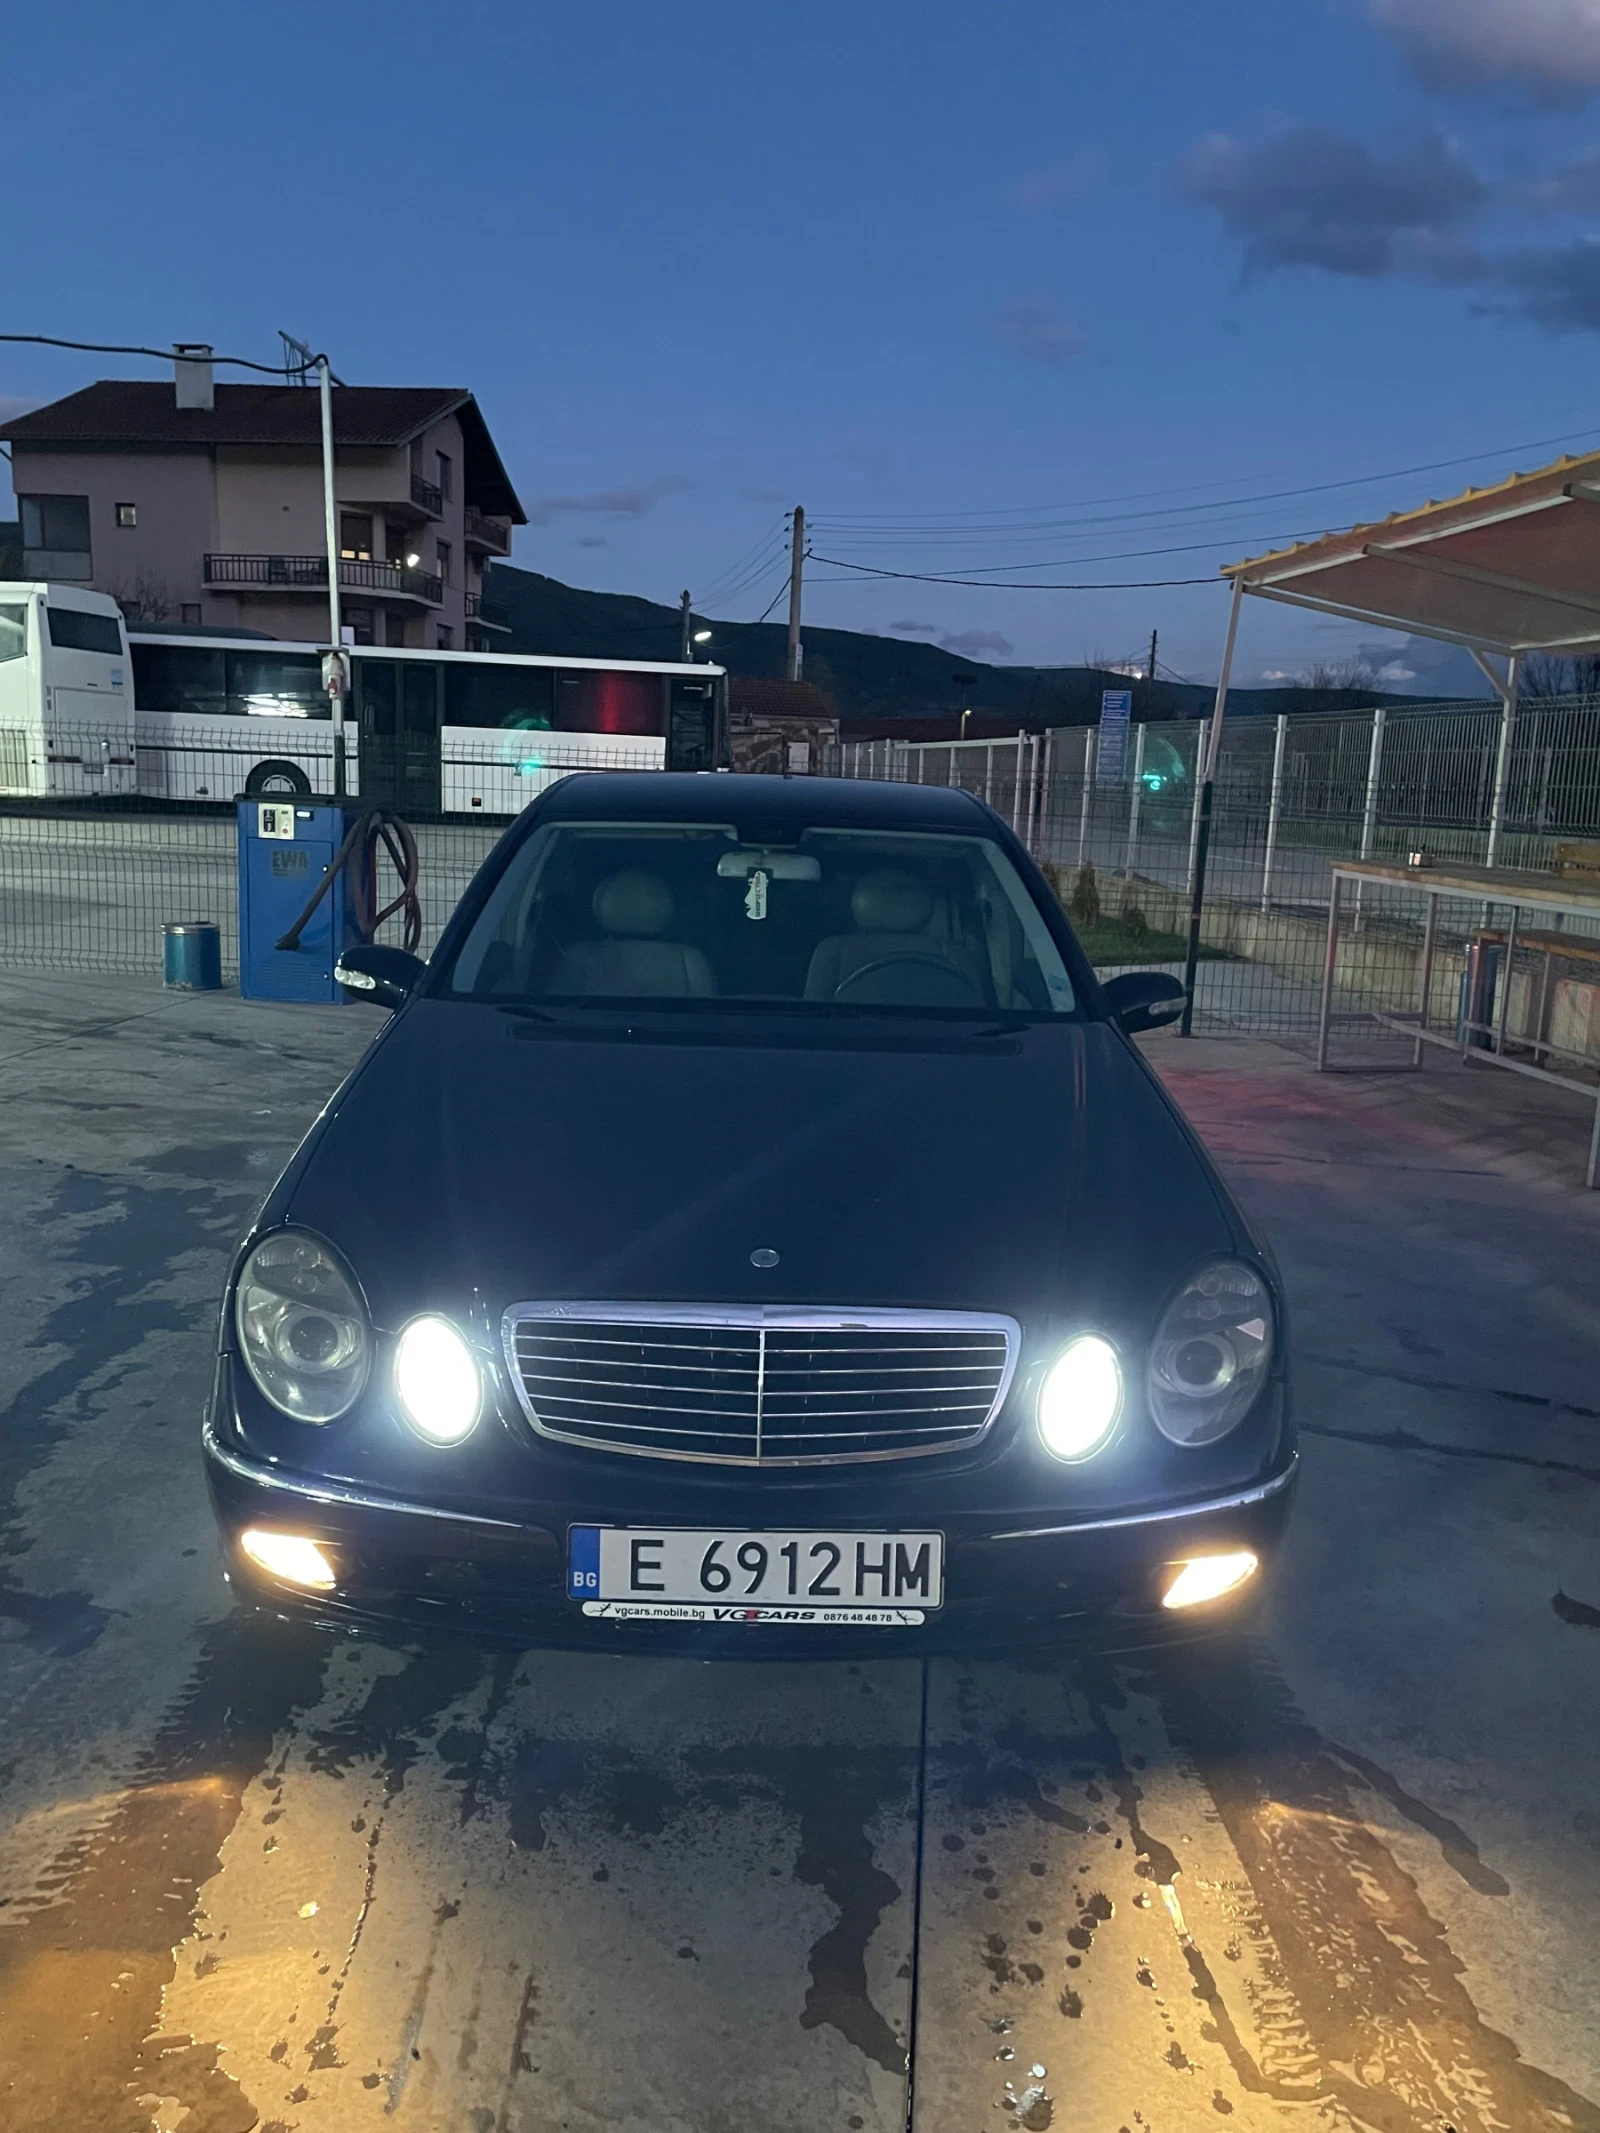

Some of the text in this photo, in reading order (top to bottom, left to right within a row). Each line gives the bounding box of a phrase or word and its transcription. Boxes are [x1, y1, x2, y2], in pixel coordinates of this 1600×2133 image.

[630, 1539, 665, 1591] E
[573, 1571, 597, 1587] BG
[614, 1606, 705, 1619] vgcars.mobile.bg
[823, 1613, 849, 1621] 0876
